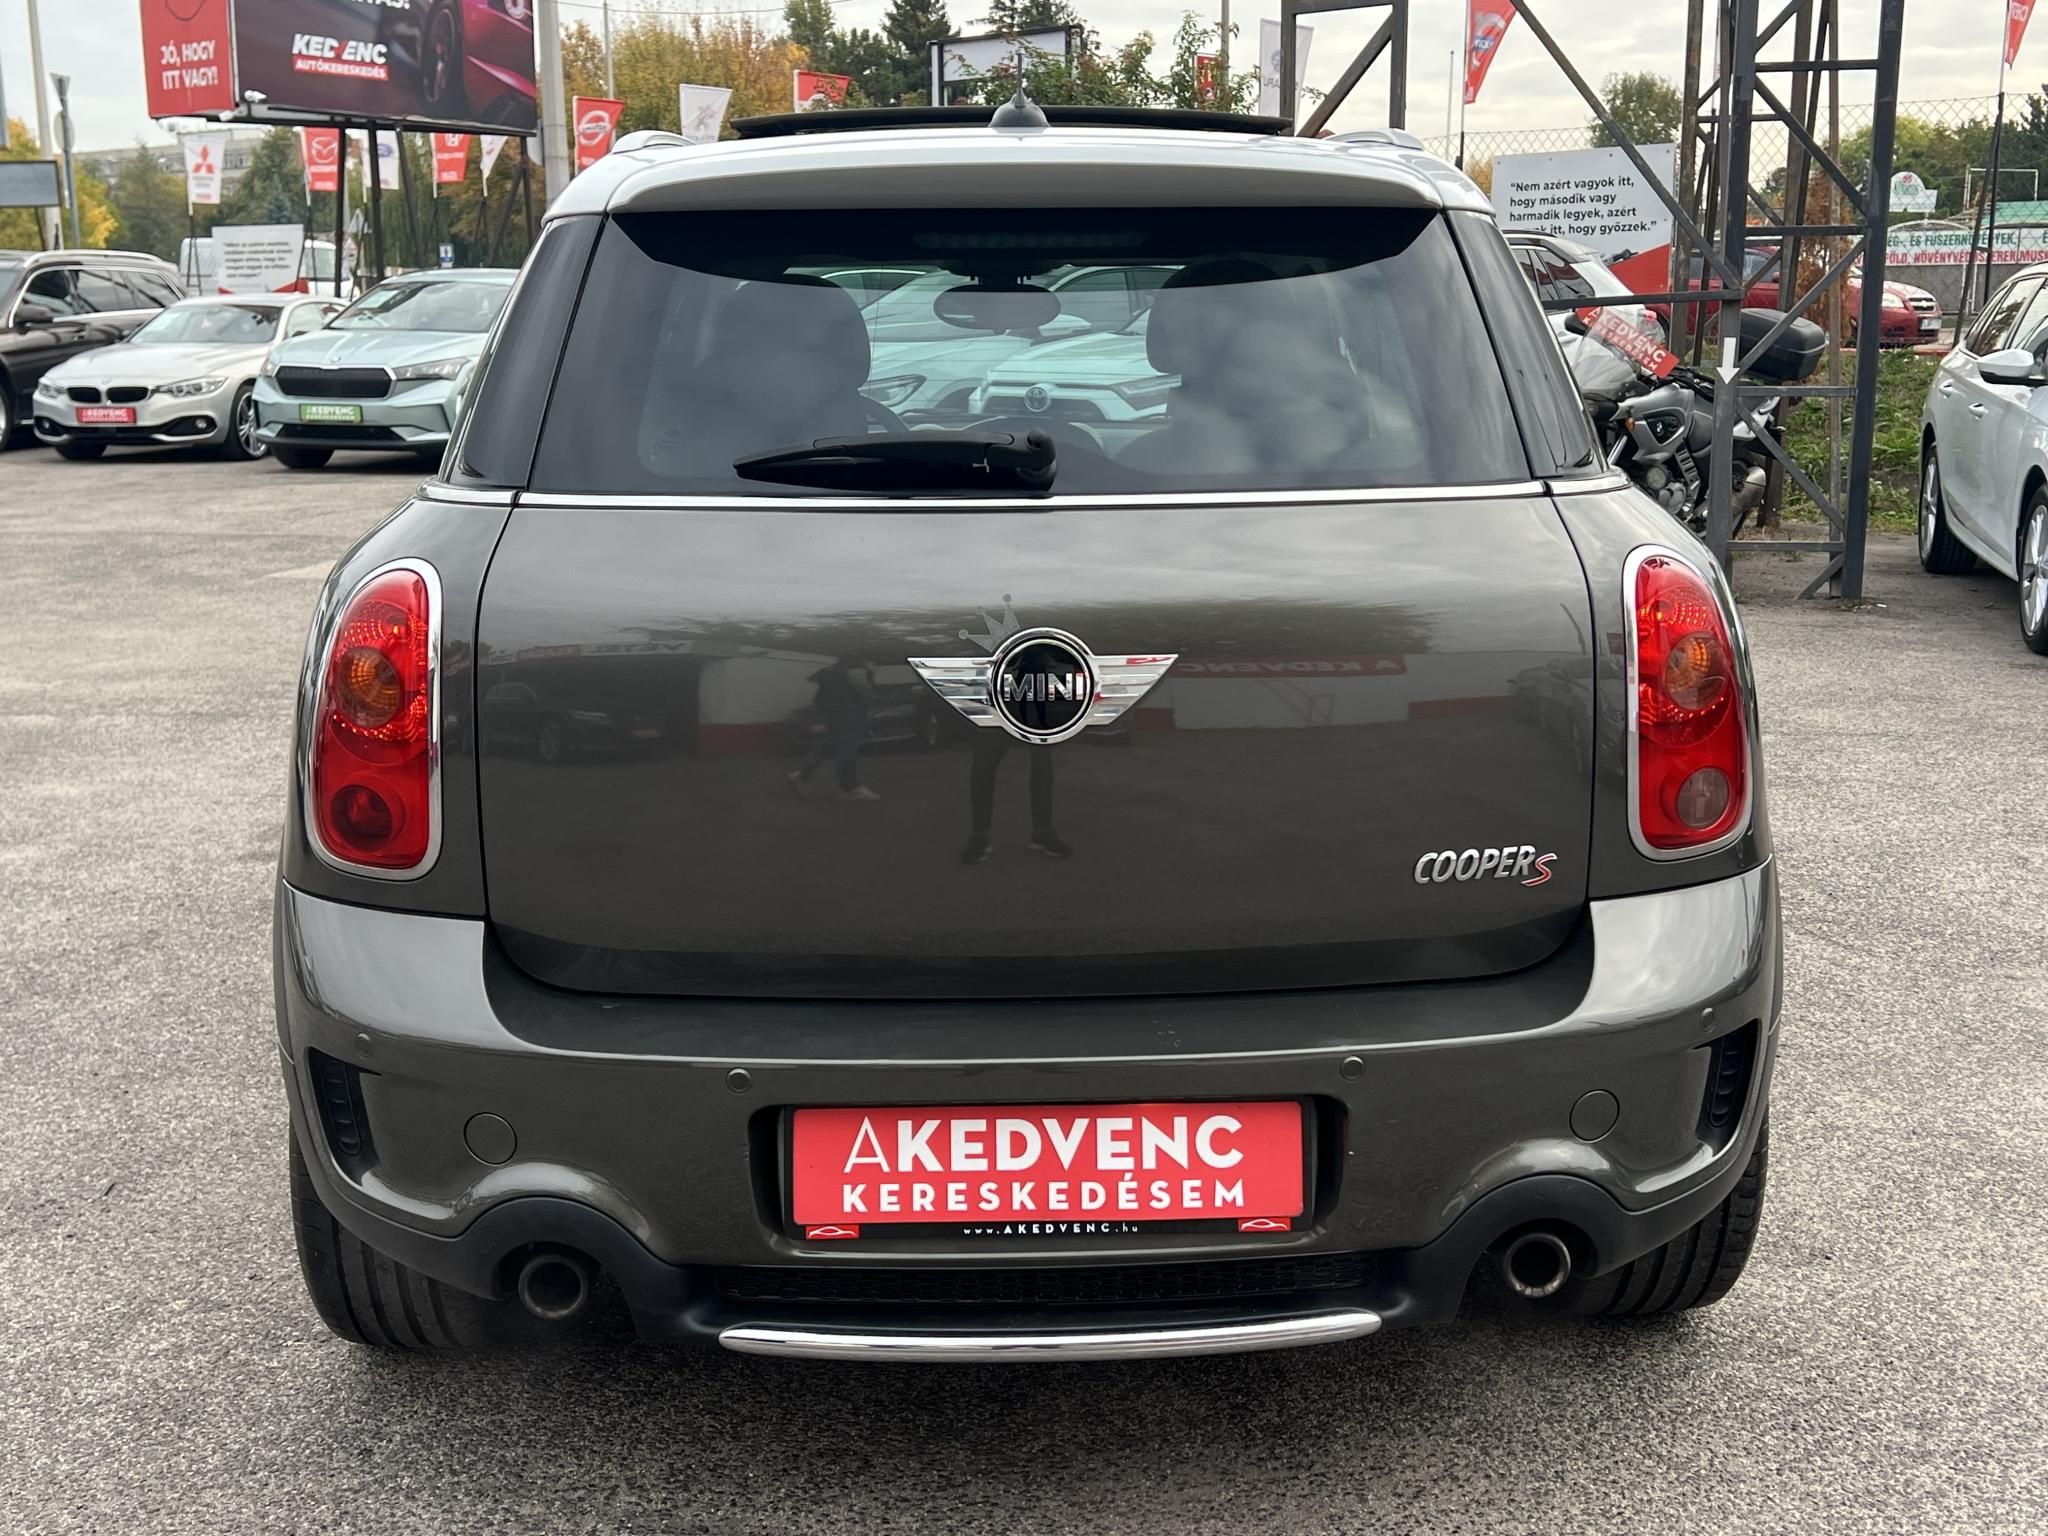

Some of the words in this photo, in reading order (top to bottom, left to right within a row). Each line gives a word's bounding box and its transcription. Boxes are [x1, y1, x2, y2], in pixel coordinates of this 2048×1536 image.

[161, 40, 181, 67] JÓ,
[182, 40, 215, 63] HOGY
[162, 70, 180, 90] ITT
[182, 66, 219, 87] VAGY!
[295, 57, 387, 79] AUTÓKERESKEDÉS
[1543, 179, 1571, 190] azért
[1574, 177, 1615, 191] vagyok
[1618, 175, 1635, 188] itt,
[1510, 197, 1536, 209] hogy
[1539, 193, 1586, 206] második
[1589, 193, 1617, 205] vagy
[1510, 209, 1560, 222] harmadik
[1563, 207, 1604, 221] legyek,
[1607, 207, 1637, 218] azért
[1550, 223, 1566, 236] itt,
[1568, 224, 1597, 236] hogy
[1003, 672, 1085, 701] MINI
[1414, 845, 1536, 884] COOPER
[1521, 853, 1558, 887] S
[842, 1172, 1244, 1213] KERESKEDÉSEM
[963, 1222, 1138, 1234] www.AKEDVENC.hu
